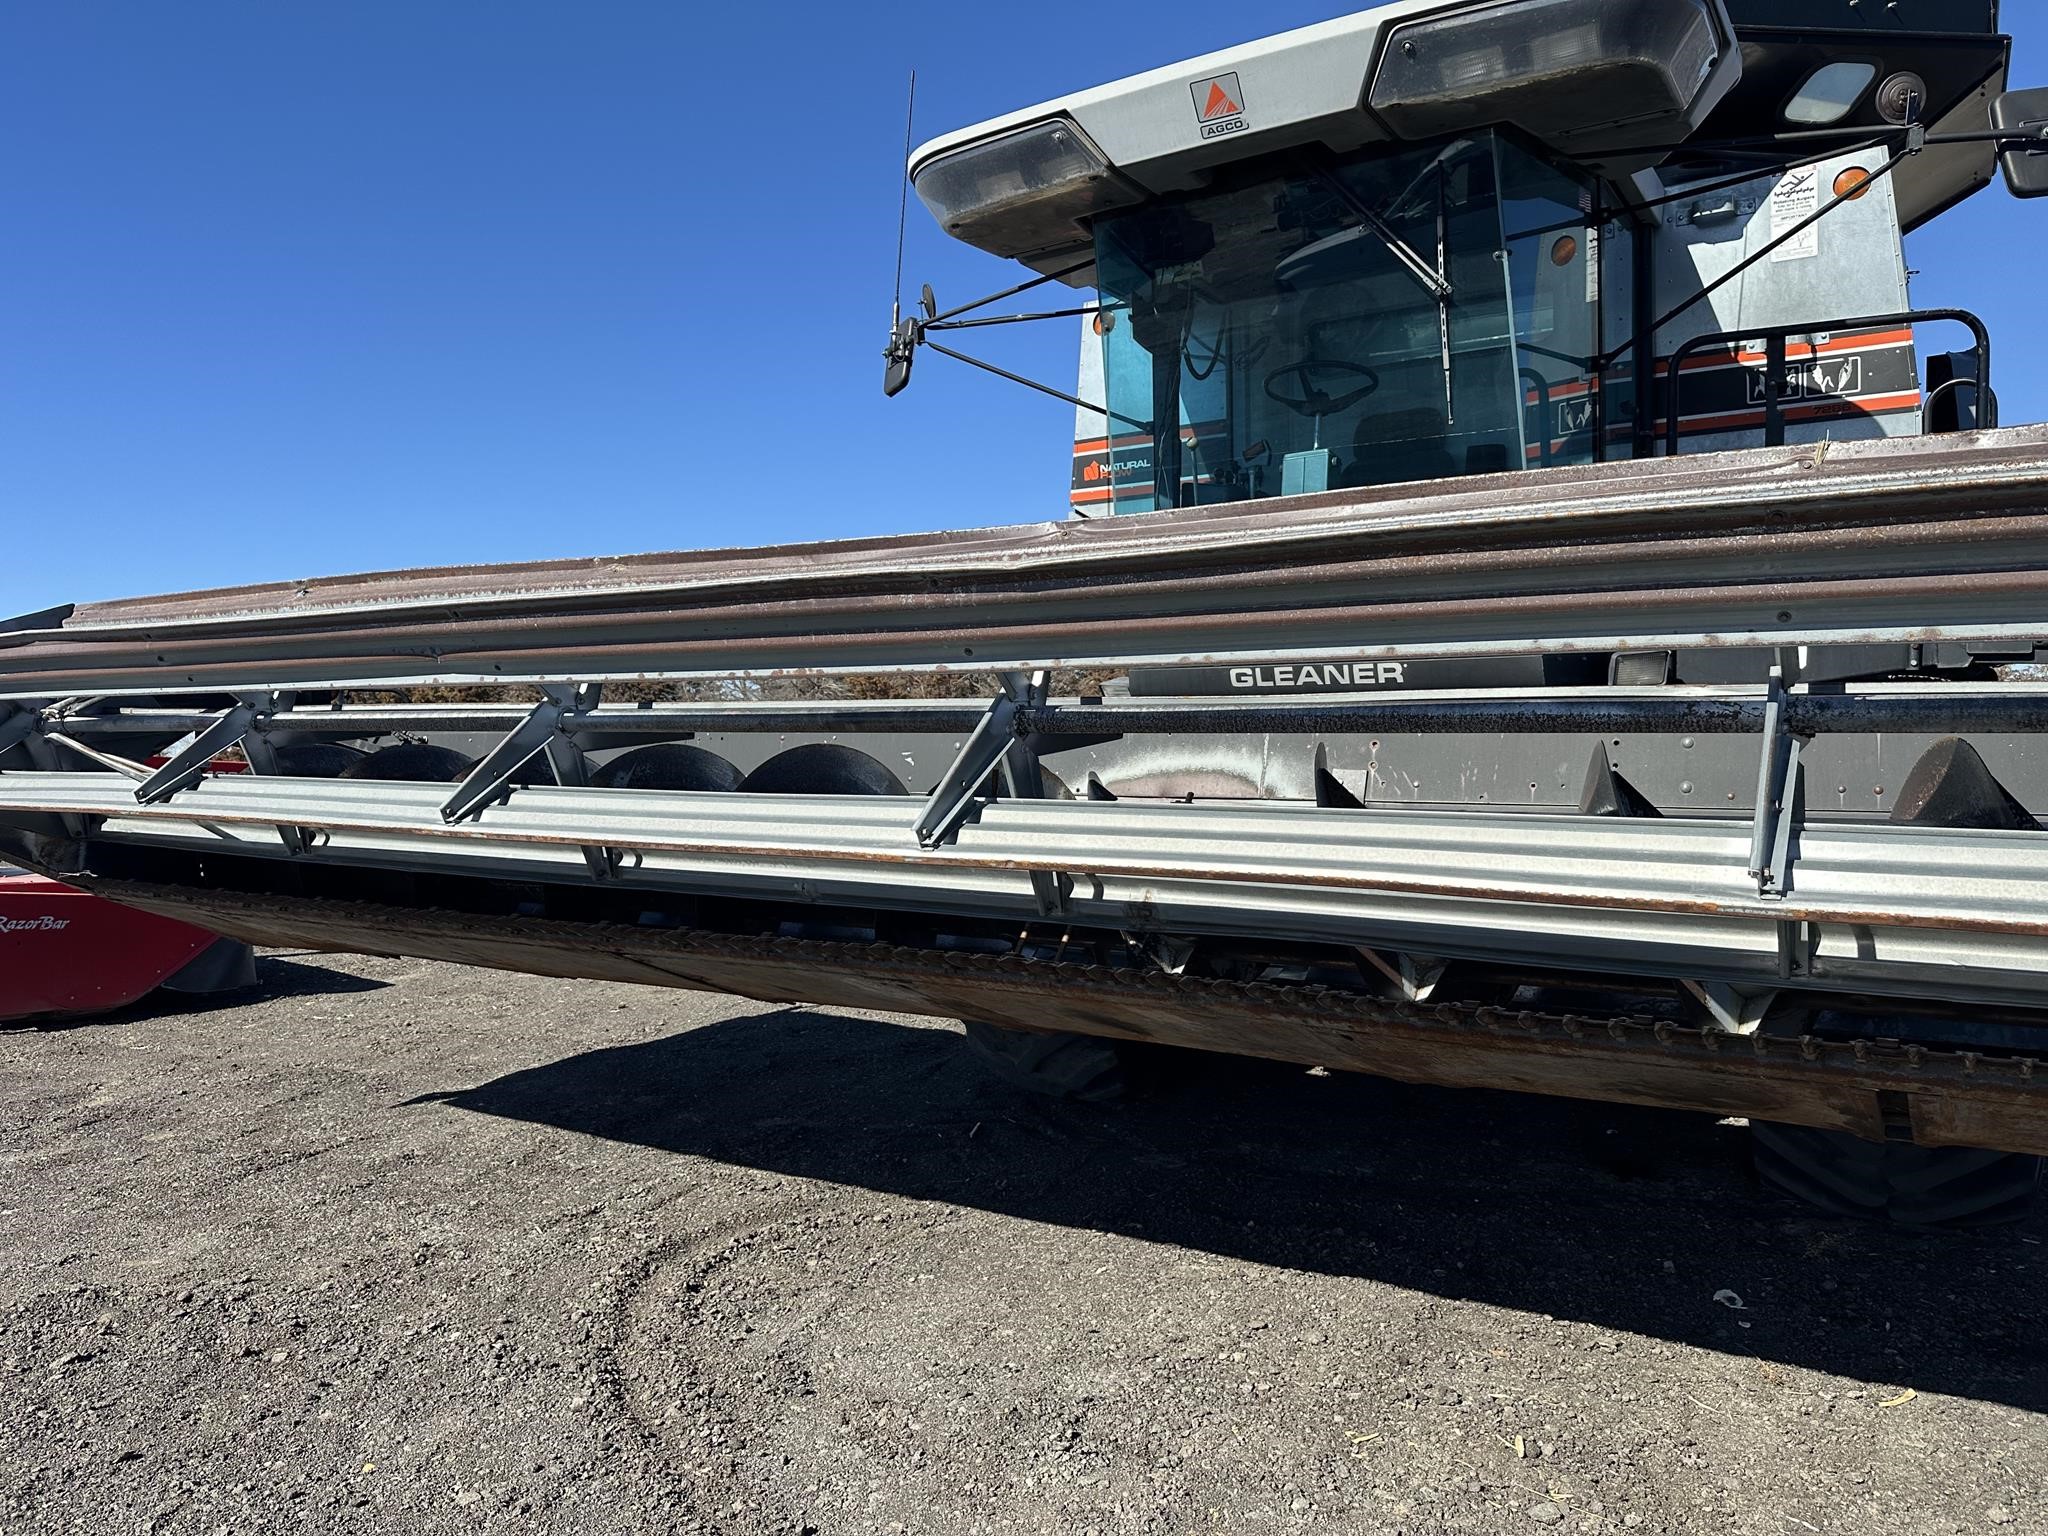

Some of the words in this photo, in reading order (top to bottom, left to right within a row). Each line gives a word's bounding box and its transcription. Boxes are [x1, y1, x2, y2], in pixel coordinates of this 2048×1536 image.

[1207, 120, 1243, 136] AGCO
[1100, 459, 1151, 473] NATURAL
[1229, 662, 1405, 687] GLEANER
[0, 915, 70, 933] RazorBar
